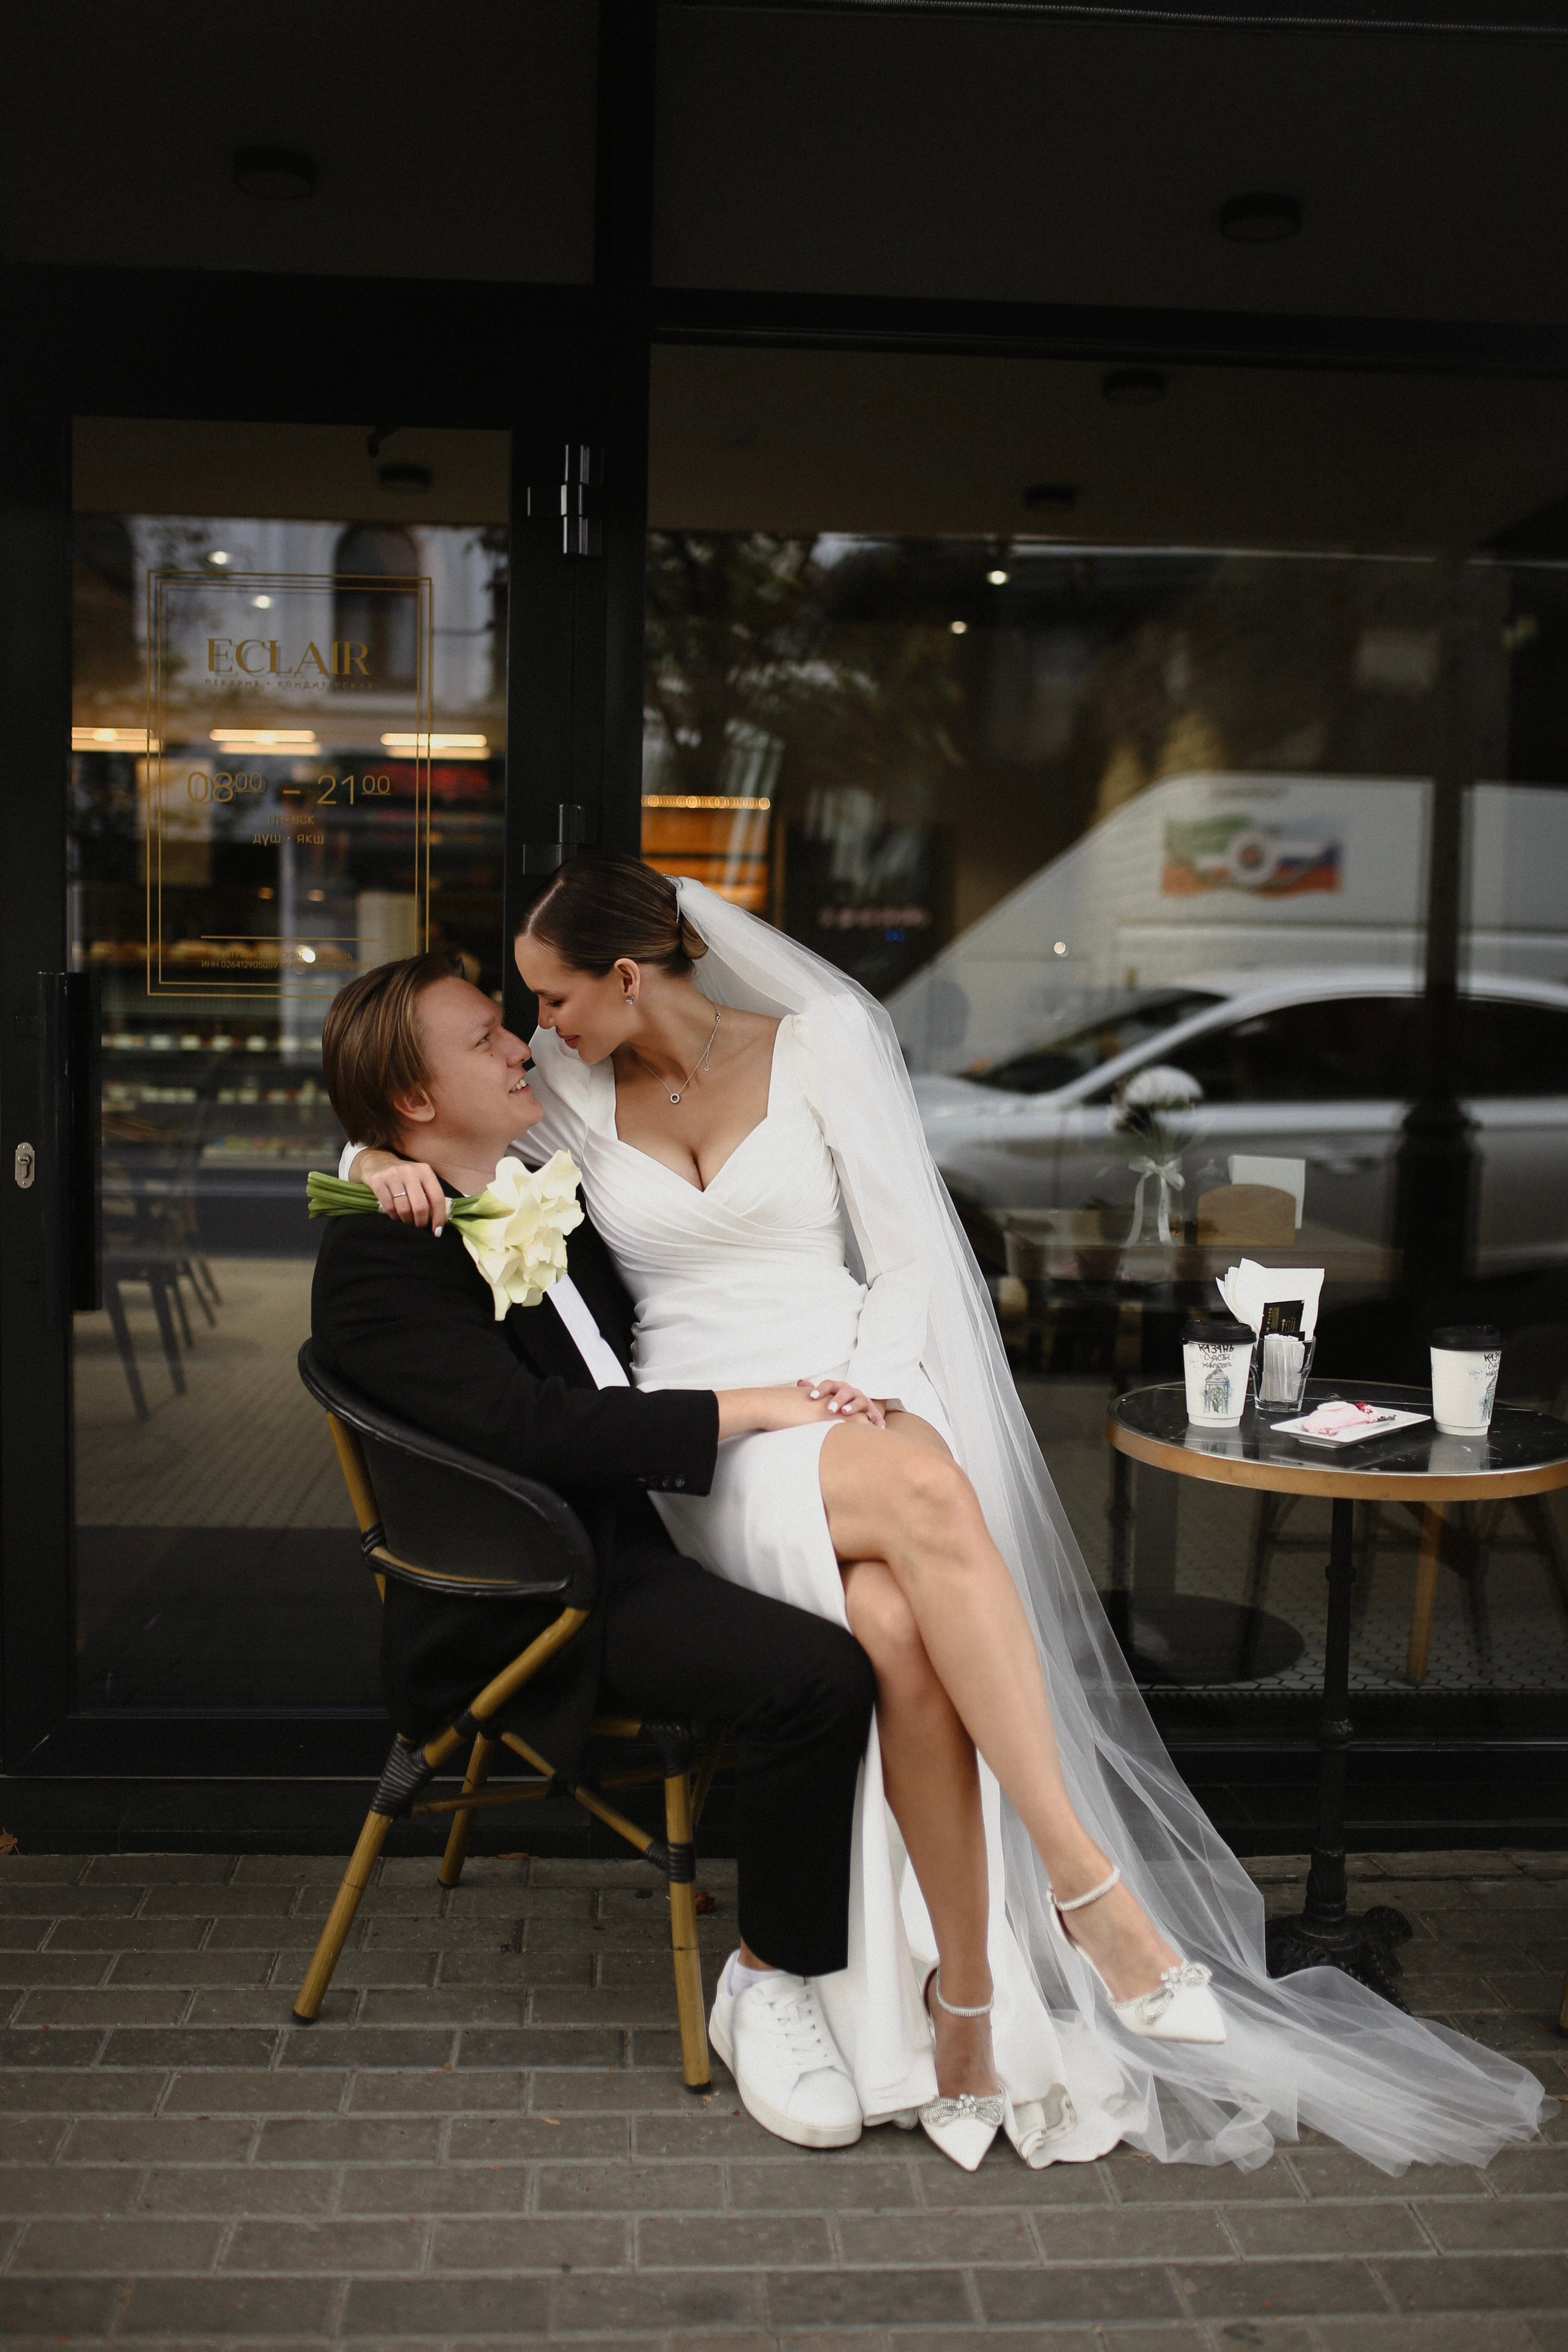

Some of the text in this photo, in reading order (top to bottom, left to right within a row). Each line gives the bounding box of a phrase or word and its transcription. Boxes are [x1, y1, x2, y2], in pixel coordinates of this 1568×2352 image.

[206, 638, 371, 676] ECLAIR
[205, 679, 260, 688] ПЕКАРНЯ
[1198, 1343, 1235, 1354] КАЗАНЬ
